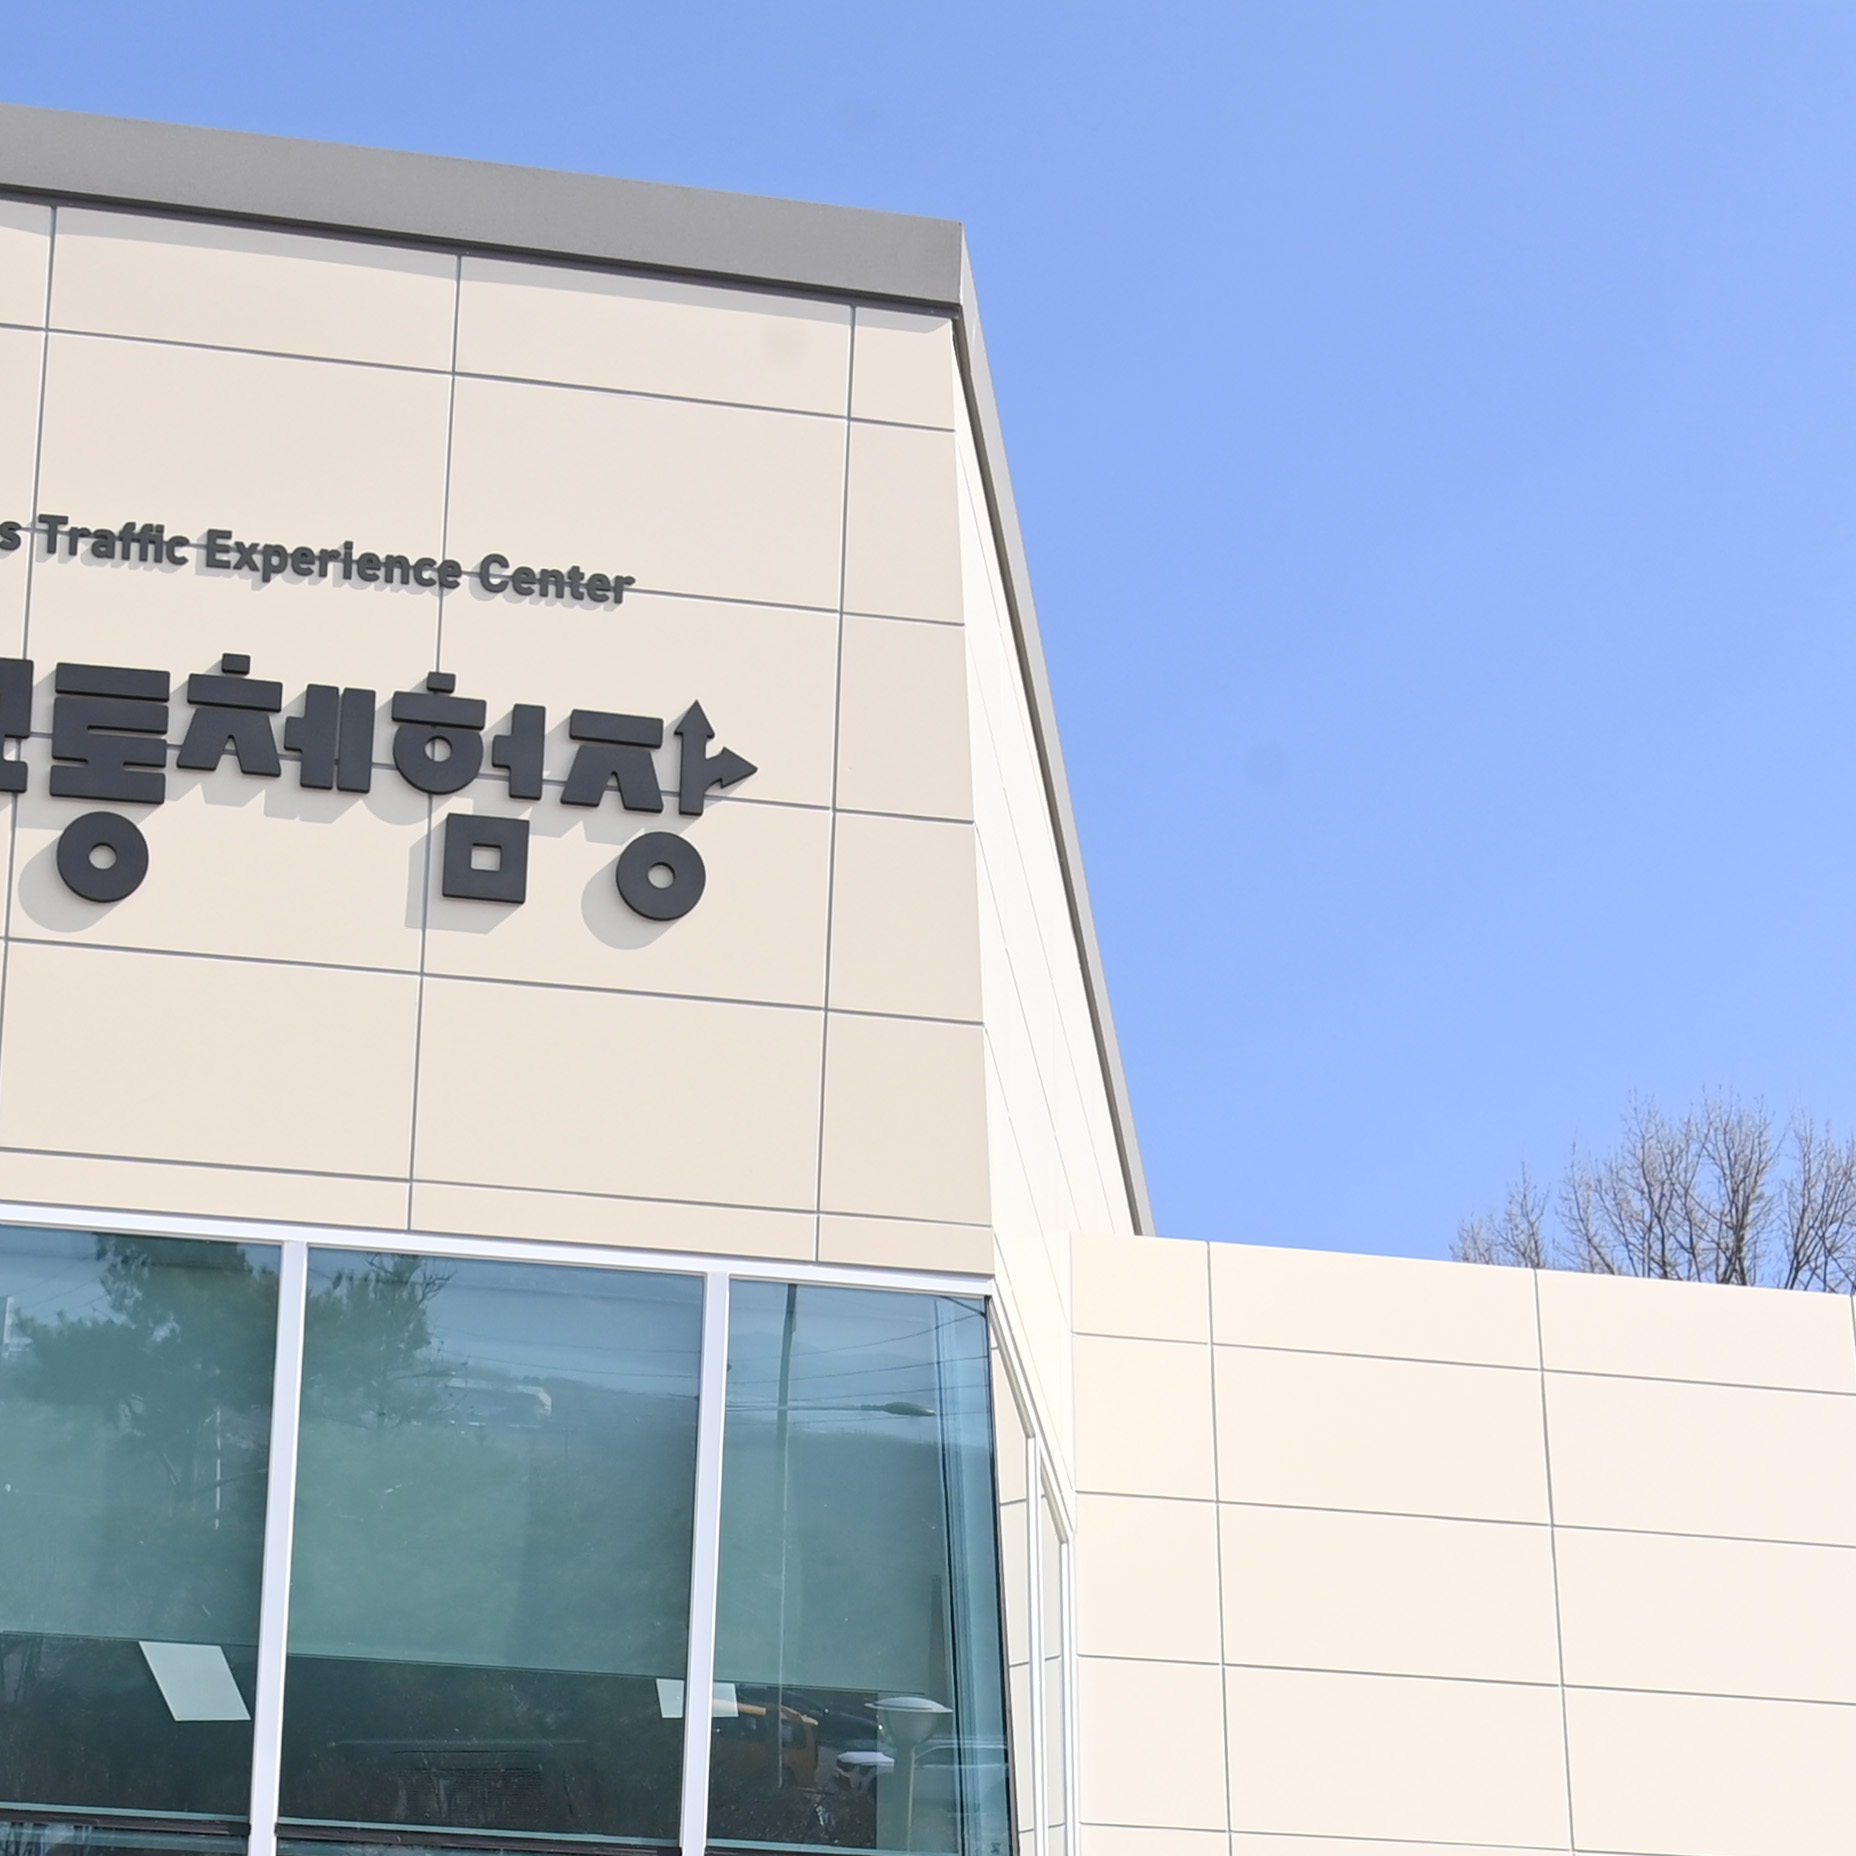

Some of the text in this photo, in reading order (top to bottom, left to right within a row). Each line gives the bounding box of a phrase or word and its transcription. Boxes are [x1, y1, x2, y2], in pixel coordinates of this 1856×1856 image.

[37, 514, 190, 566] Traffic
[202, 536, 463, 590] Experience
[477, 553, 636, 605] Center
